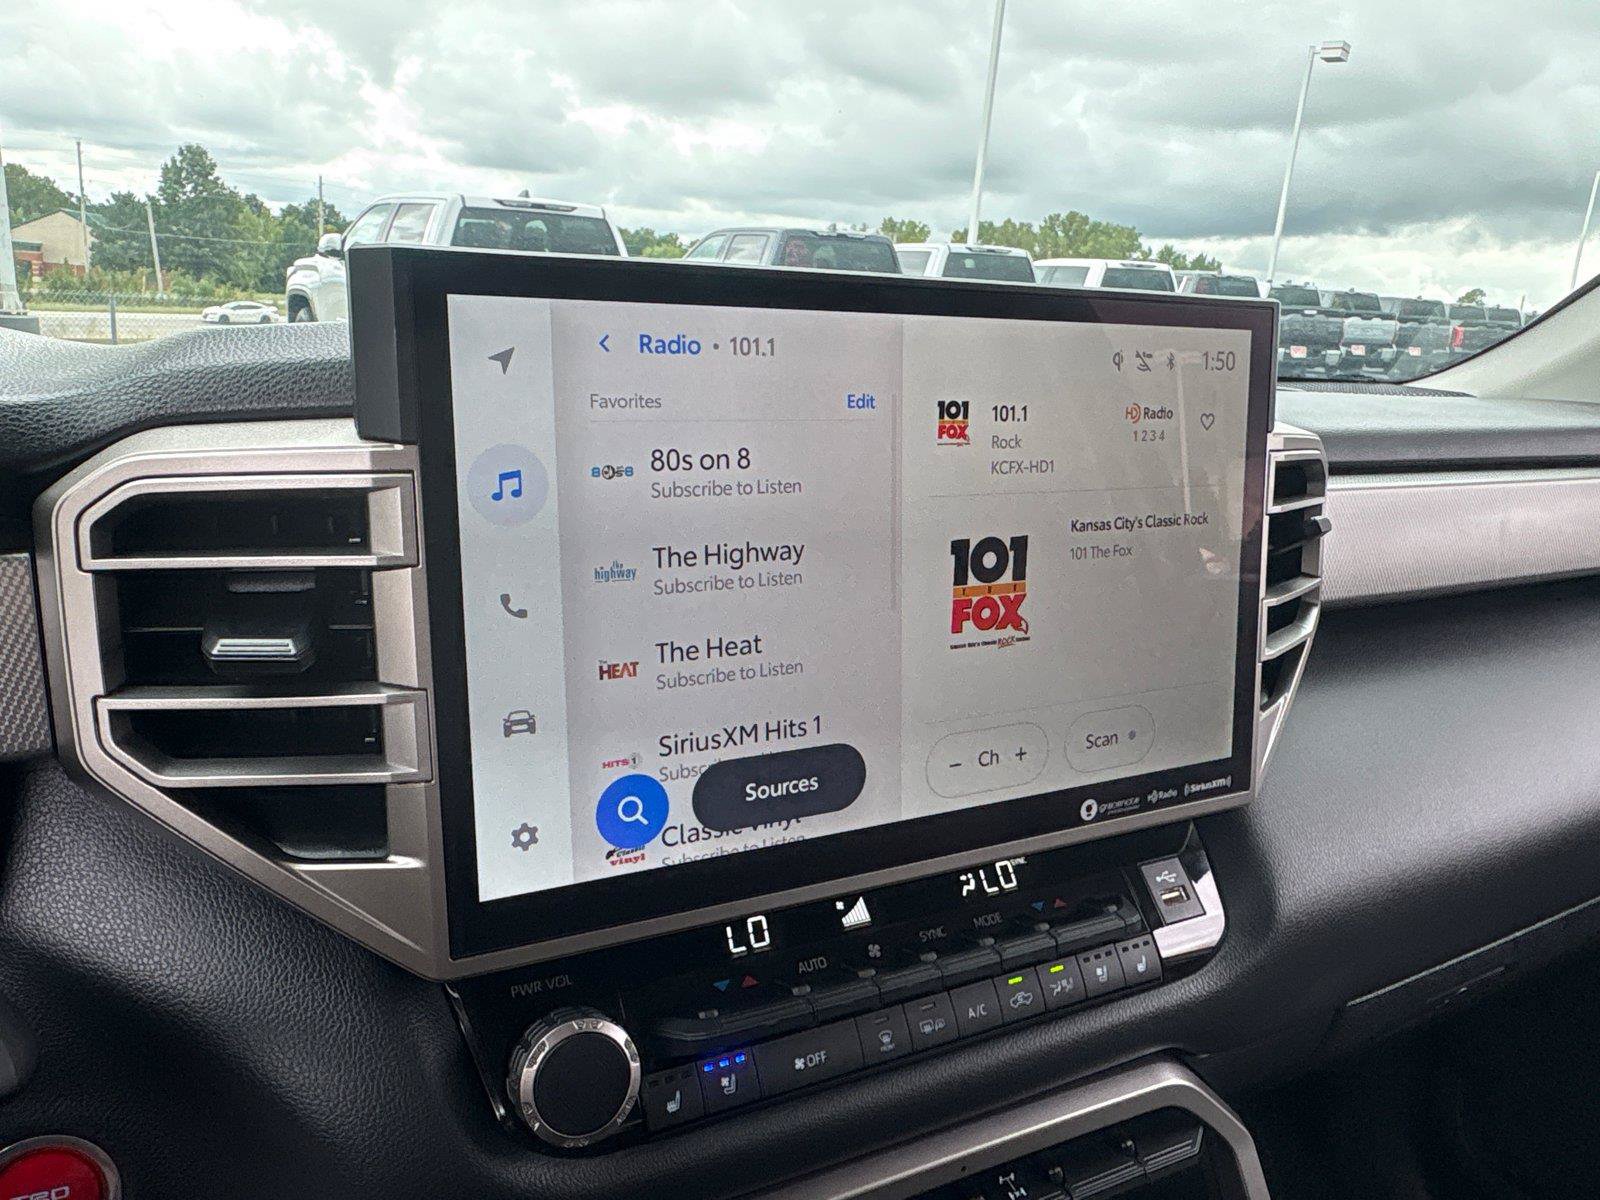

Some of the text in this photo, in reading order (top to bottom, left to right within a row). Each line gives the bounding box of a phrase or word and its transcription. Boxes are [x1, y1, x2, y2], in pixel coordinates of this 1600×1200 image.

[638, 334, 777, 357] Radio 101.1
[1202, 351, 1236, 371] 1:50
[590, 393, 663, 410] Favorites
[847, 394, 876, 410] Edit
[937, 400, 970, 420] 101
[992, 405, 1028, 422] 101.1
[1143, 405, 1174, 420] Radio
[938, 424, 970, 440] FOX
[991, 434, 1022, 449] Rock
[650, 447, 750, 472] 80s on 8
[990, 459, 1055, 475] KCFX-HD1
[651, 479, 802, 499] Subscribe to Listen
[1071, 512, 1209, 533] Kansas City's Classic Rock
[652, 542, 805, 570] The Highway
[951, 534, 1029, 588] 101
[1070, 543, 1133, 561] 101 The Fox
[594, 566, 637, 583] highway
[653, 571, 803, 596] Subscribe to Listen
[951, 593, 1030, 635] FOX
[655, 635, 762, 664] The Heat
[598, 660, 639, 680] HEAT
[656, 659, 804, 690] Subscribe to Listen
[658, 715, 822, 758] SiriusXM Hits 1
[1086, 734, 1119, 750] Scan
[978, 751, 999, 768] Ch
[745, 775, 820, 802] Sources
[610, 854, 646, 866] vinyl
[973, 911, 1002, 929] MODE
[918, 926, 949, 944] SYNC
[798, 957, 828, 974] AUTO
[509, 975, 574, 999] PWR VOL
[967, 1003, 987, 1020] A/C
[806, 1050, 828, 1068] OFF
